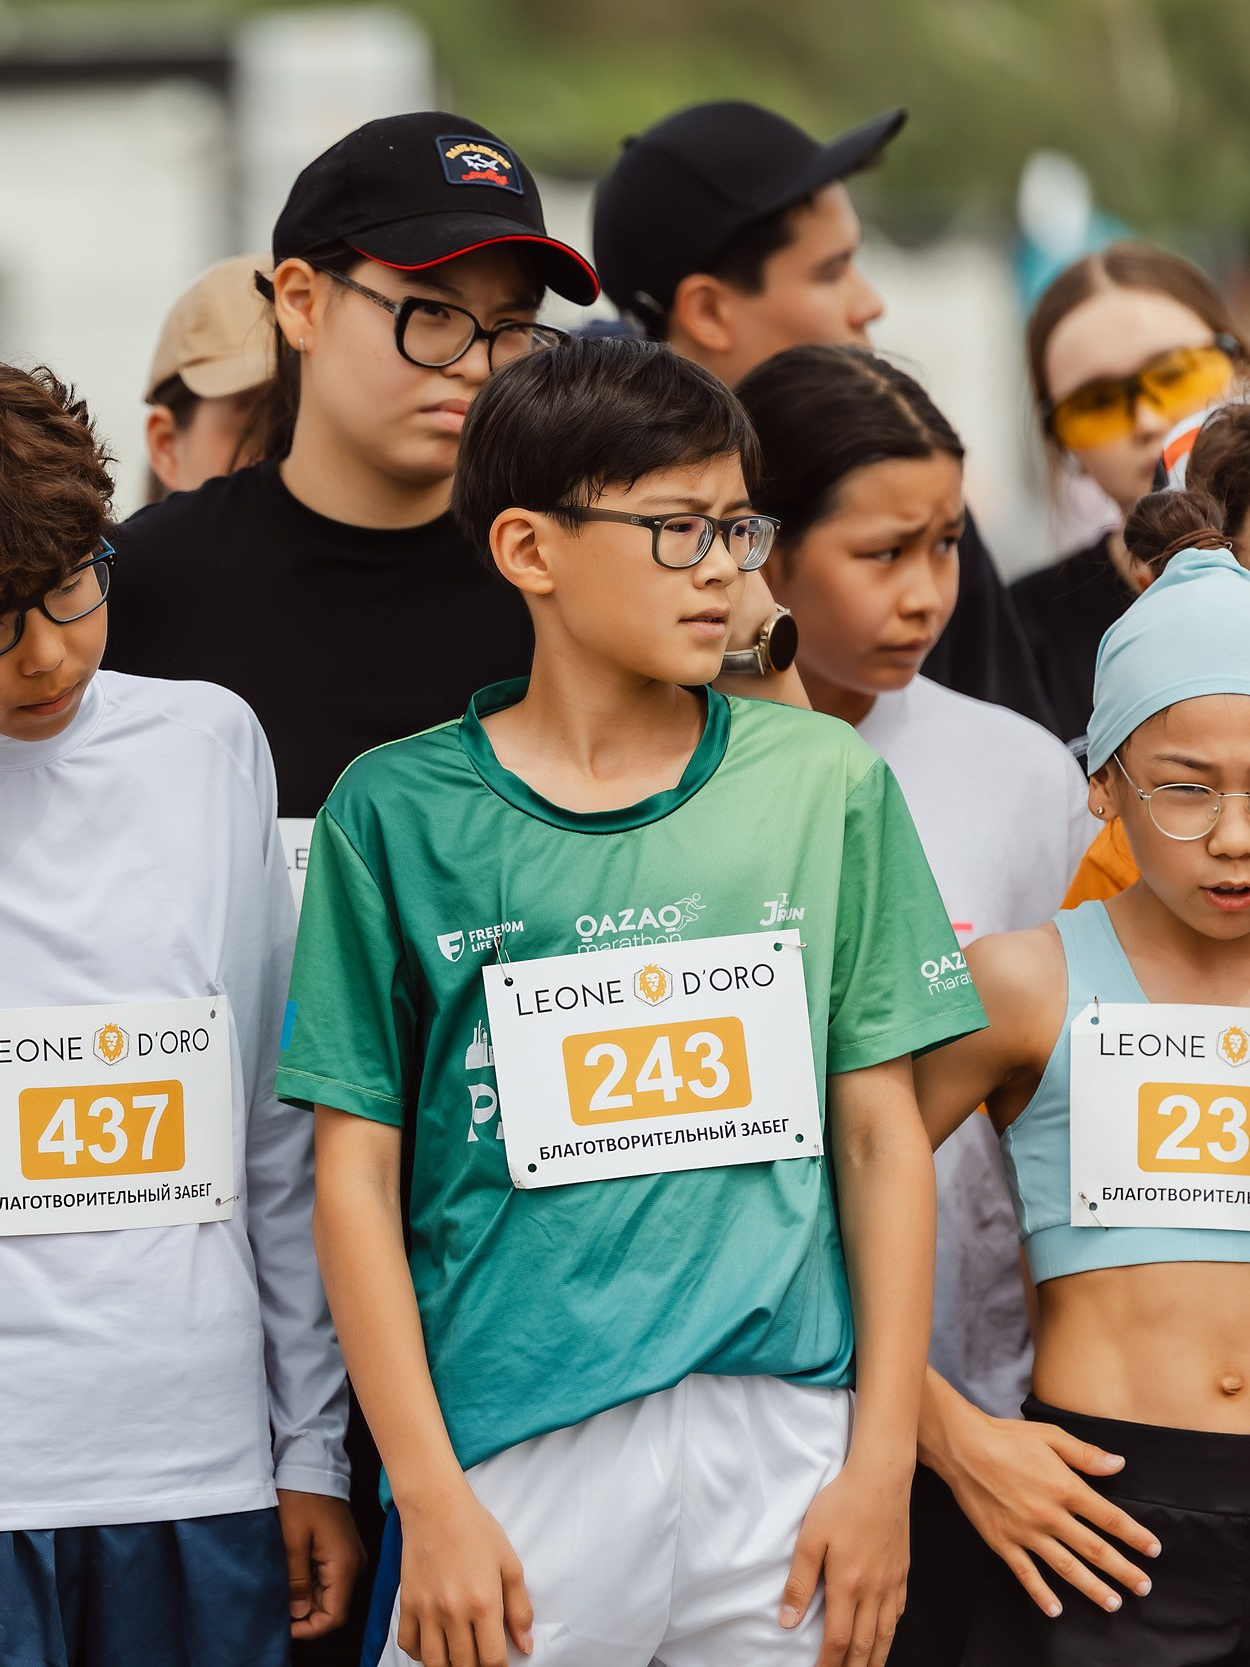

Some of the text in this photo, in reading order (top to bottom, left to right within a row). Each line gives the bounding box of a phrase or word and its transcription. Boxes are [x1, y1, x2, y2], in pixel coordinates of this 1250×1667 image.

[471, 940, 492, 953] LIFE
[920, 951, 967, 983] QAZ
[516, 964, 775, 1016] LEONE D'ORO
[928, 972, 973, 996] marat
[138, 1028, 210, 1056] D'ORO
[1100, 1032, 1206, 1058] LEONE
[584, 1031, 731, 1112] 243
[37, 1093, 169, 1166] 437
[539, 1118, 790, 1161] БЛАГОТВОРИТЕЛЬНЫЙ ЗАБЕГ
[1155, 1094, 1250, 1163] 23
[174, 1182, 212, 1201] ЗАБЕГ
